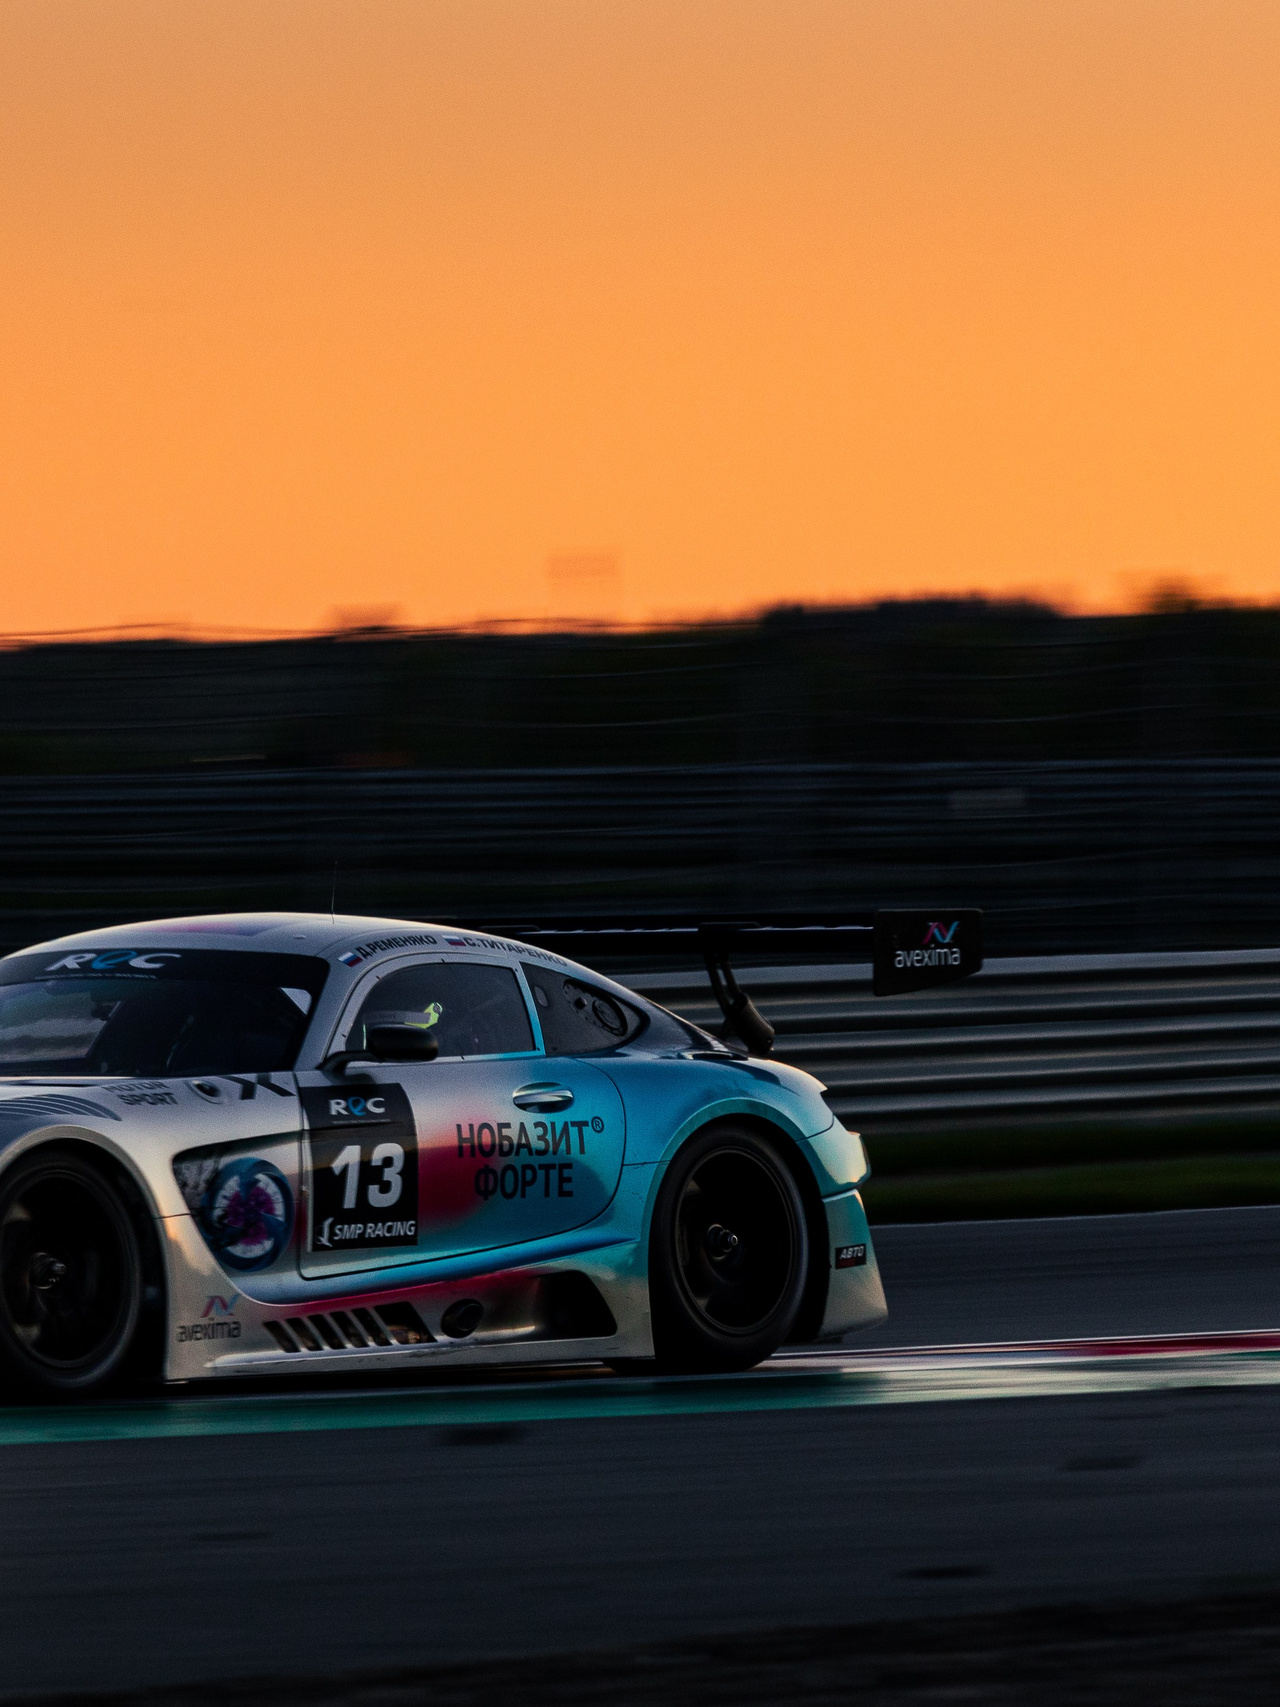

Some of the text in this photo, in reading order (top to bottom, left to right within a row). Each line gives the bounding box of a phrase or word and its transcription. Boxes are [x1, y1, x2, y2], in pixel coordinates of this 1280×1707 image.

[464, 936, 568, 967] С.ТИТАРЕНКО
[893, 944, 961, 968] avexima
[117, 1092, 178, 1105] SPORT
[329, 1142, 406, 1209] 13
[474, 1162, 574, 1200] ФОРТЕ
[332, 1220, 416, 1241] SMP RACING
[177, 1317, 241, 1342] avexima
